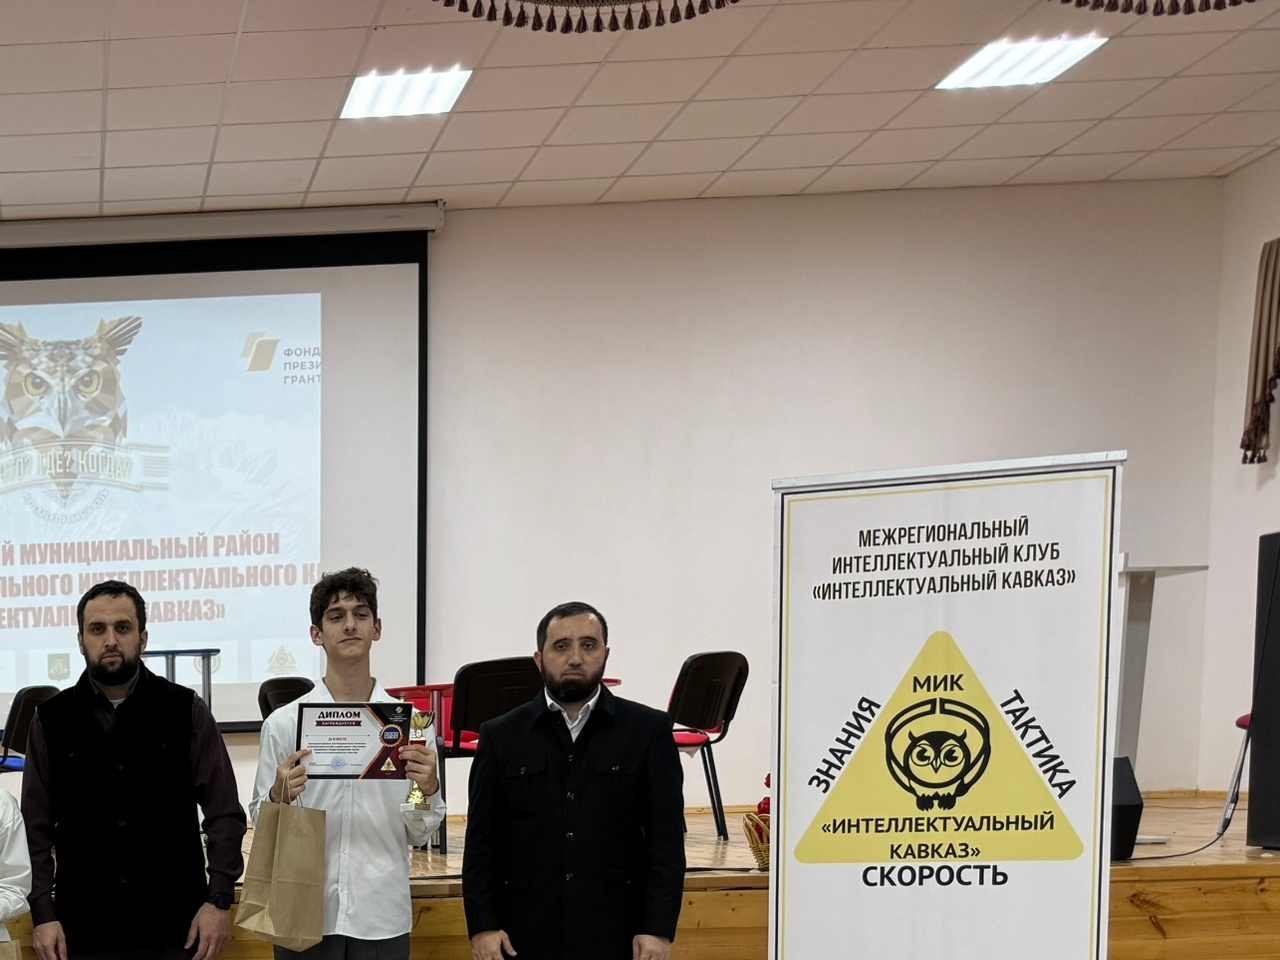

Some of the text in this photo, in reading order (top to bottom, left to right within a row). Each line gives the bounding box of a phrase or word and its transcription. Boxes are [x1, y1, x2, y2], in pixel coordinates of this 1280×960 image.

[38, 450, 71, 476] ГДЕ?
[78, 449, 131, 480] КОГДА?
[20, 532, 208, 565] МУНИЦИПАЛЬНЫЙ
[213, 529, 280, 558] РАЙОН
[858, 515, 1029, 548] МЕЖРЕГИОНАЛЬНЫЙ
[832, 542, 1060, 574] ИНТЕЛЛЕКТУАЛЬНЫЙ КЛУБ
[812, 568, 1076, 600] «ИНТЕЛЛЕКТУАЛЬНЫЙ КАВКАЗ»
[913, 674, 964, 693] МИК
[318, 711, 361, 719] ДИПЛОМ
[808, 696, 881, 794] ЗНАНИЯ
[1000, 688, 1077, 799] ТАКТИКА
[821, 811, 1055, 834] «ИНТЕЛЛЕКТУАЛЬНЫЙ
[890, 843, 981, 859] КАВКАЗ»
[862, 865, 1009, 887] СКОРОСТЬ
